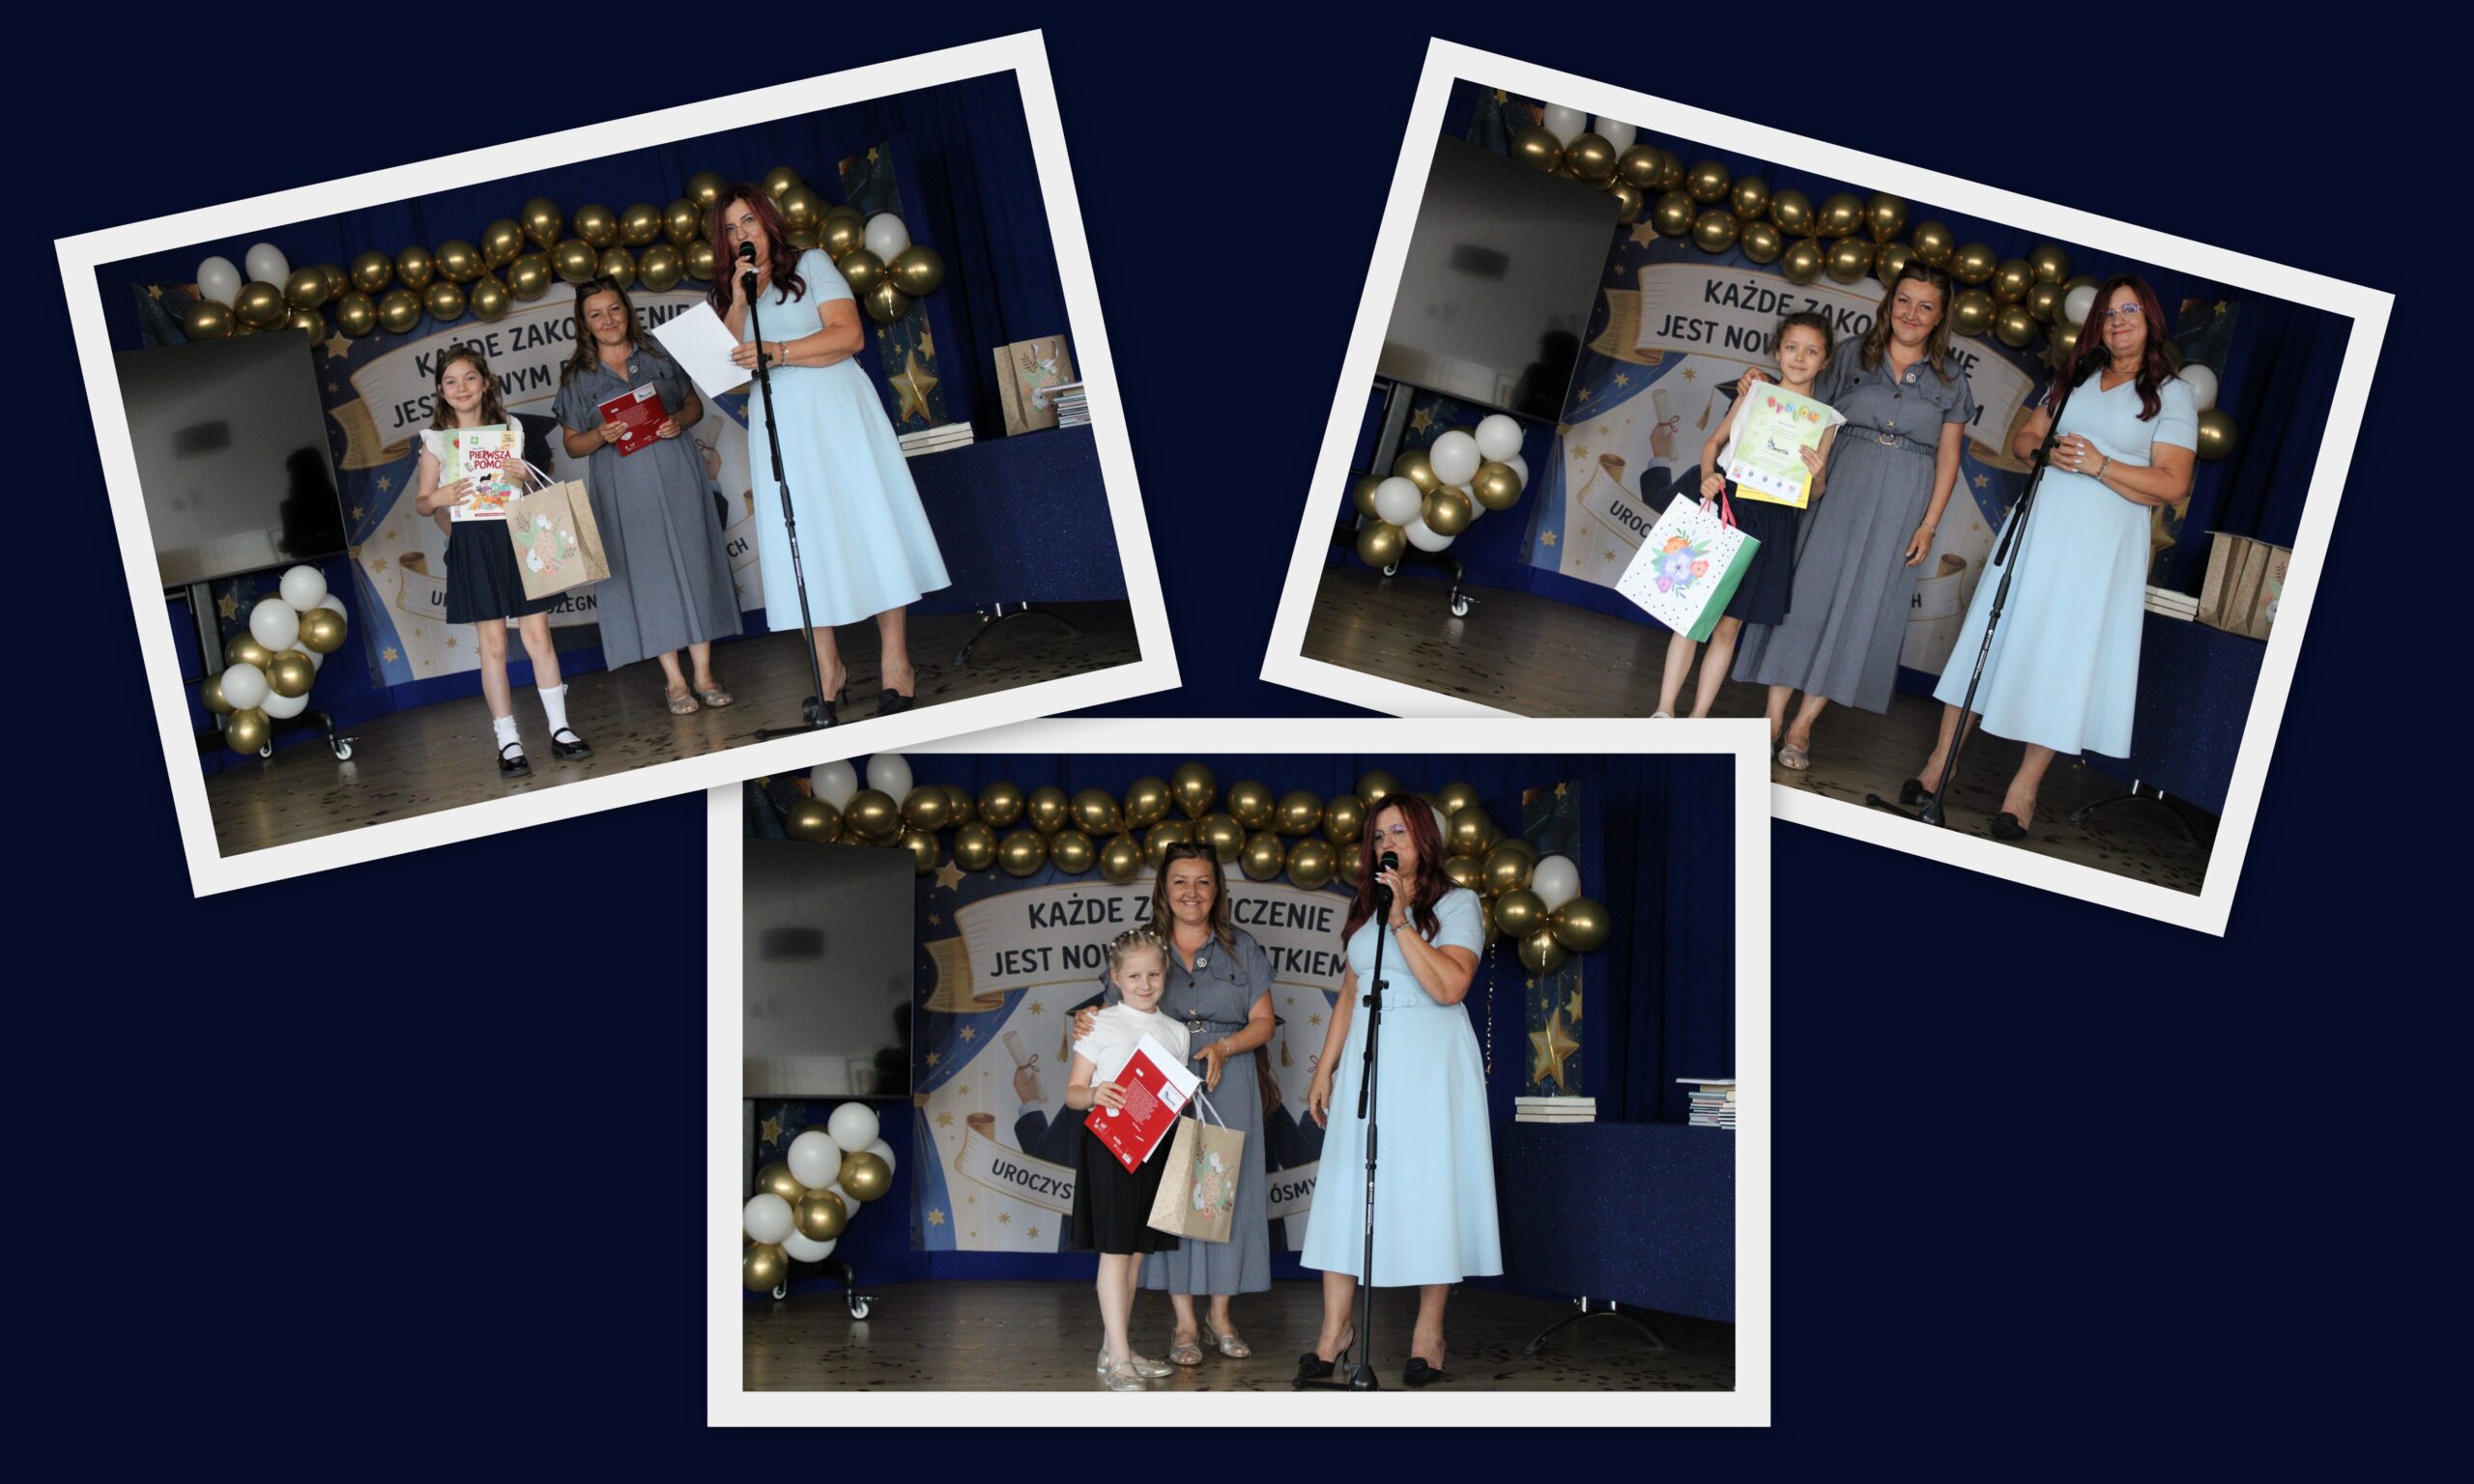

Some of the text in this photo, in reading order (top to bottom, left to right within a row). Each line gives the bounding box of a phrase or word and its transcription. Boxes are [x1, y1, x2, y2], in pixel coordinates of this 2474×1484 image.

[1705, 279, 1795, 317] KAŻDE
[1656, 315, 1718, 344] JEST
[393, 393, 437, 428] JES
[469, 450, 510, 460] PIERWSZA
[474, 460, 502, 470] POMO
[1028, 893, 1124, 929] KAŻDE
[991, 947, 1053, 977] JEST
[991, 1158, 1076, 1200] UROCZYS
